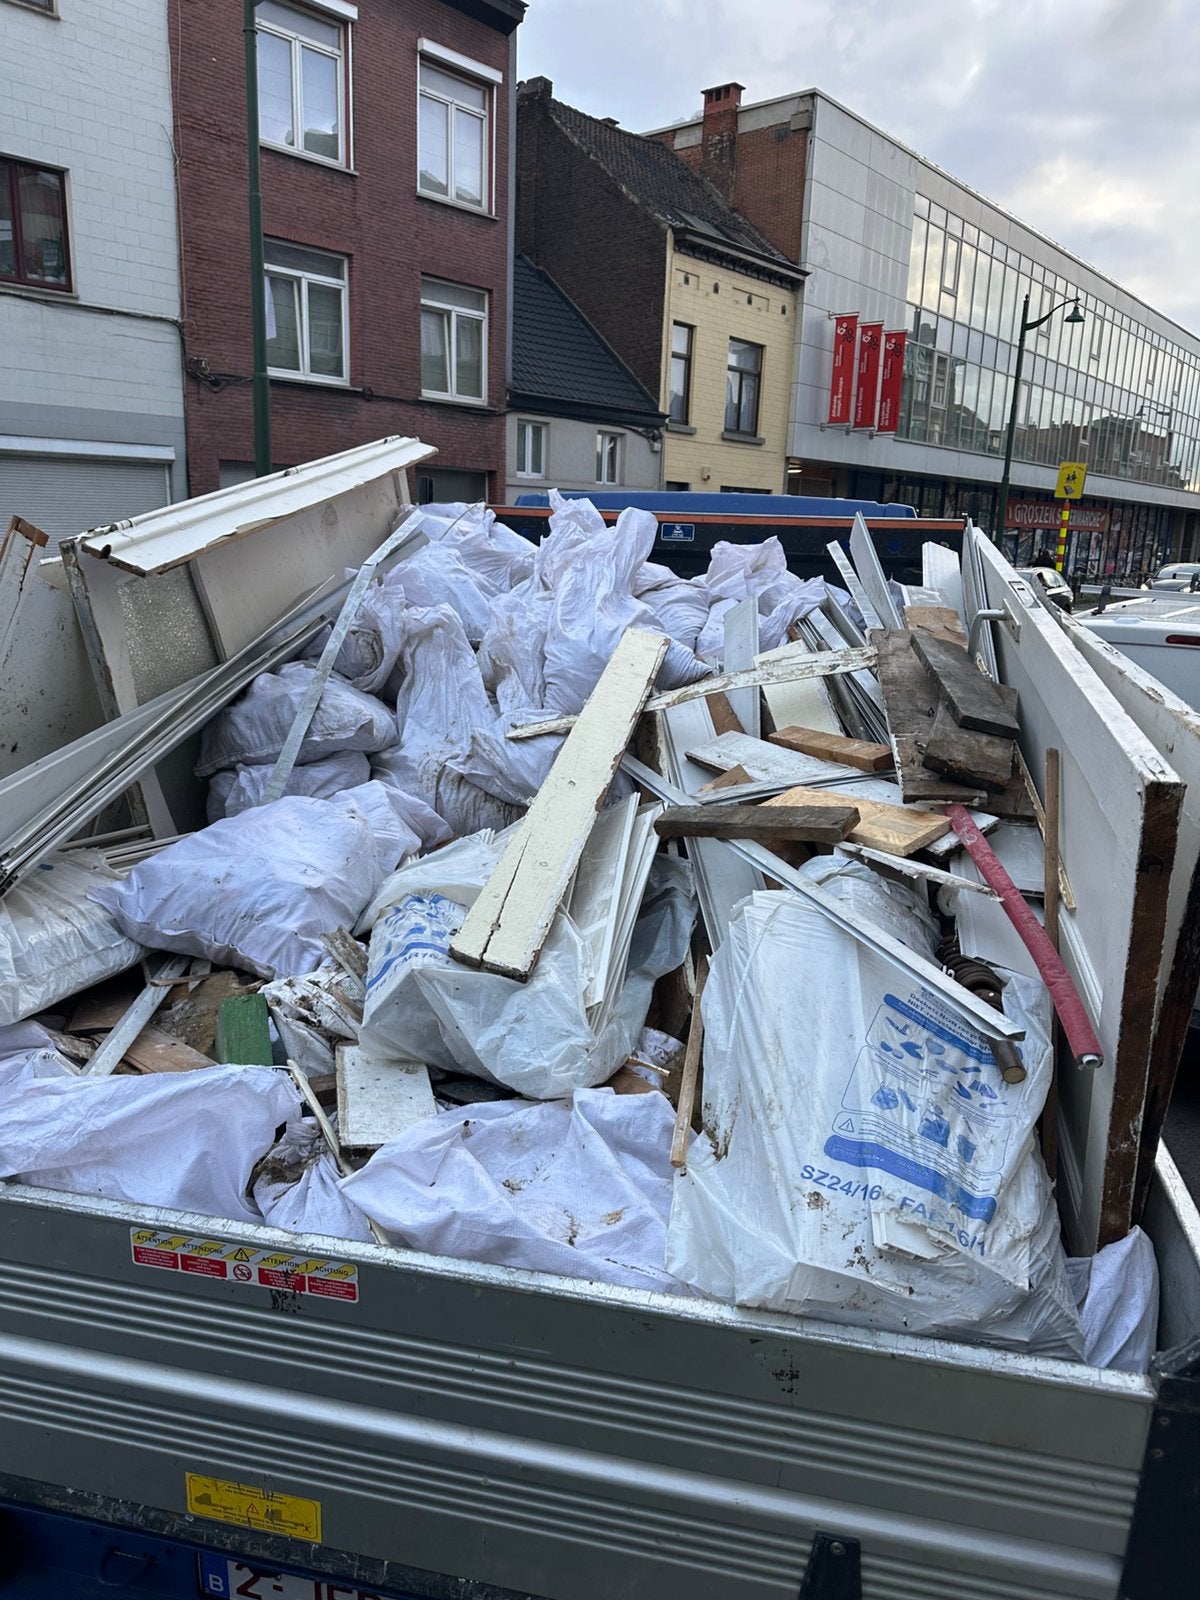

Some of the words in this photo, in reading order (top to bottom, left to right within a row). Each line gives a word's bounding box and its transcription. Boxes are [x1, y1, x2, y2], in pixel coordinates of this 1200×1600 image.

[800, 1164, 883, 1201] SZ24/16
[136, 1234, 173, 1246] ATTENTION
[262, 1256, 300, 1268] ATTENTION
[315, 1265, 350, 1276] ACHTUNG
[208, 1573, 224, 1592] B
